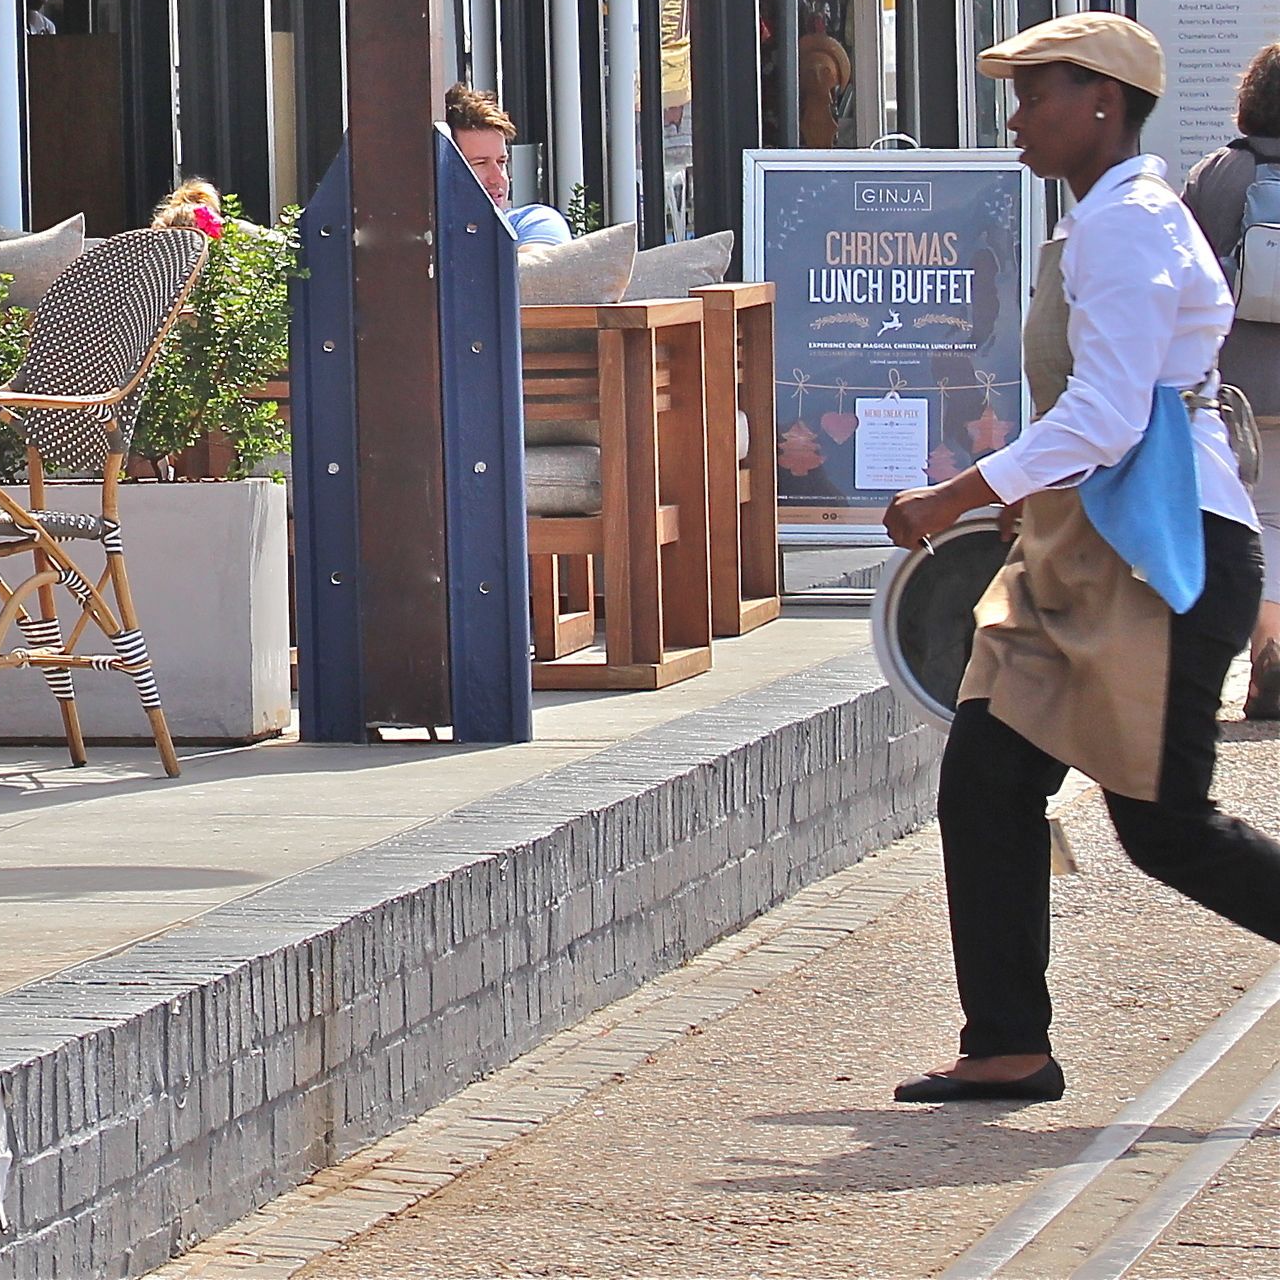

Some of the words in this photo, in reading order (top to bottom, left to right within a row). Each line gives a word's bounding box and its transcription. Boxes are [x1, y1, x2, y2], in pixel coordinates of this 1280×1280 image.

[862, 188, 925, 204] GINJA
[825, 231, 958, 267] CHRISTMAS
[809, 268, 884, 305] LUNCH
[891, 268, 975, 305] BUFFET
